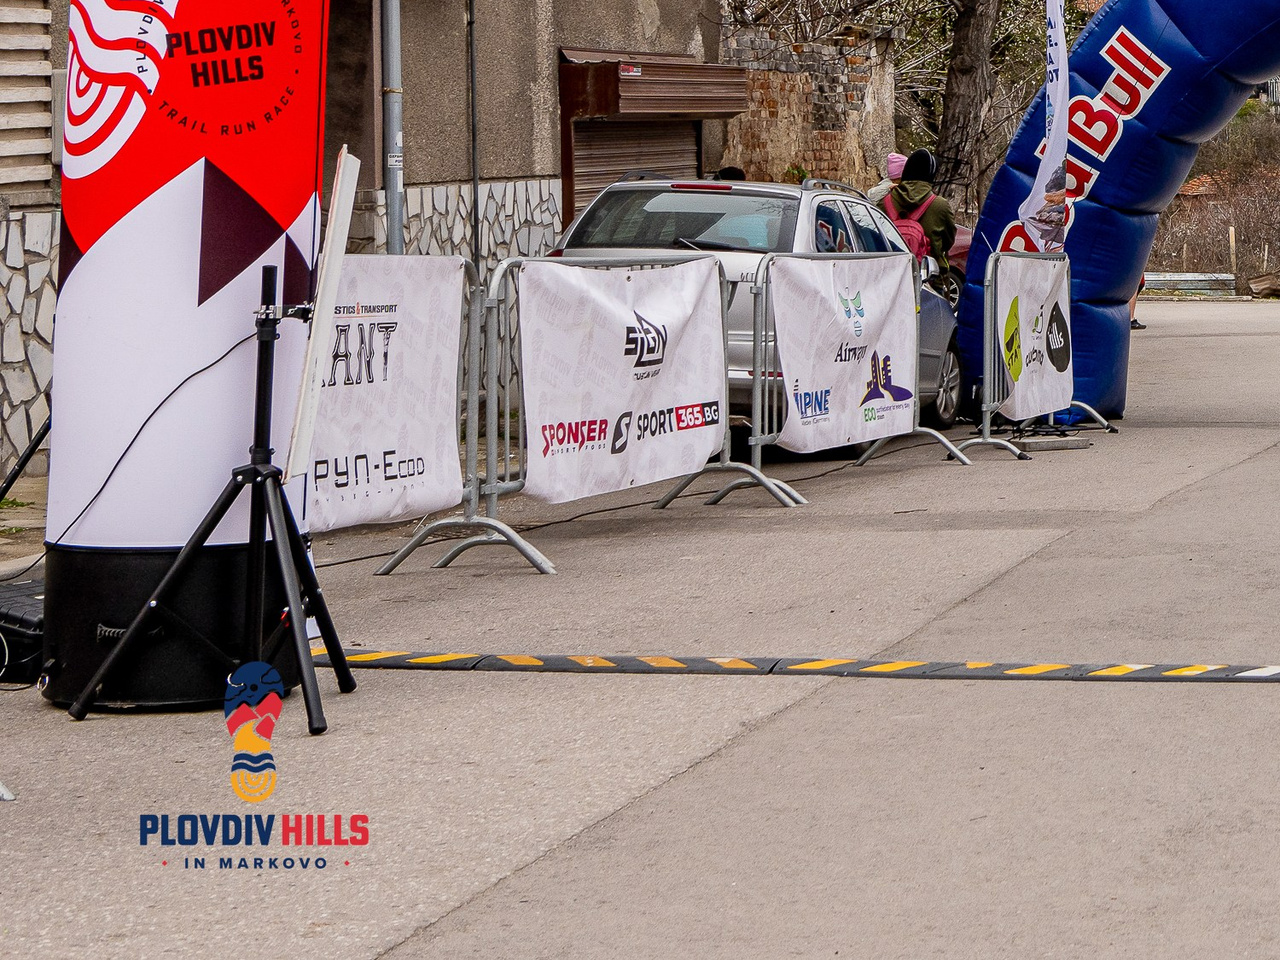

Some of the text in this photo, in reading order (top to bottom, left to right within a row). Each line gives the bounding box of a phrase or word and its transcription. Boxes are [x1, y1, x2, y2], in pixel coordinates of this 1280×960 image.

[165, 21, 276, 58] PLOVDIV
[190, 55, 264, 88] HILLS
[158, 86, 294, 136] TRAIL RUN RACE
[1066, 29, 1168, 160] Bull
[361, 304, 398, 314] TRANSPORT
[321, 322, 398, 388] ANT
[541, 419, 609, 458] SPONSER
